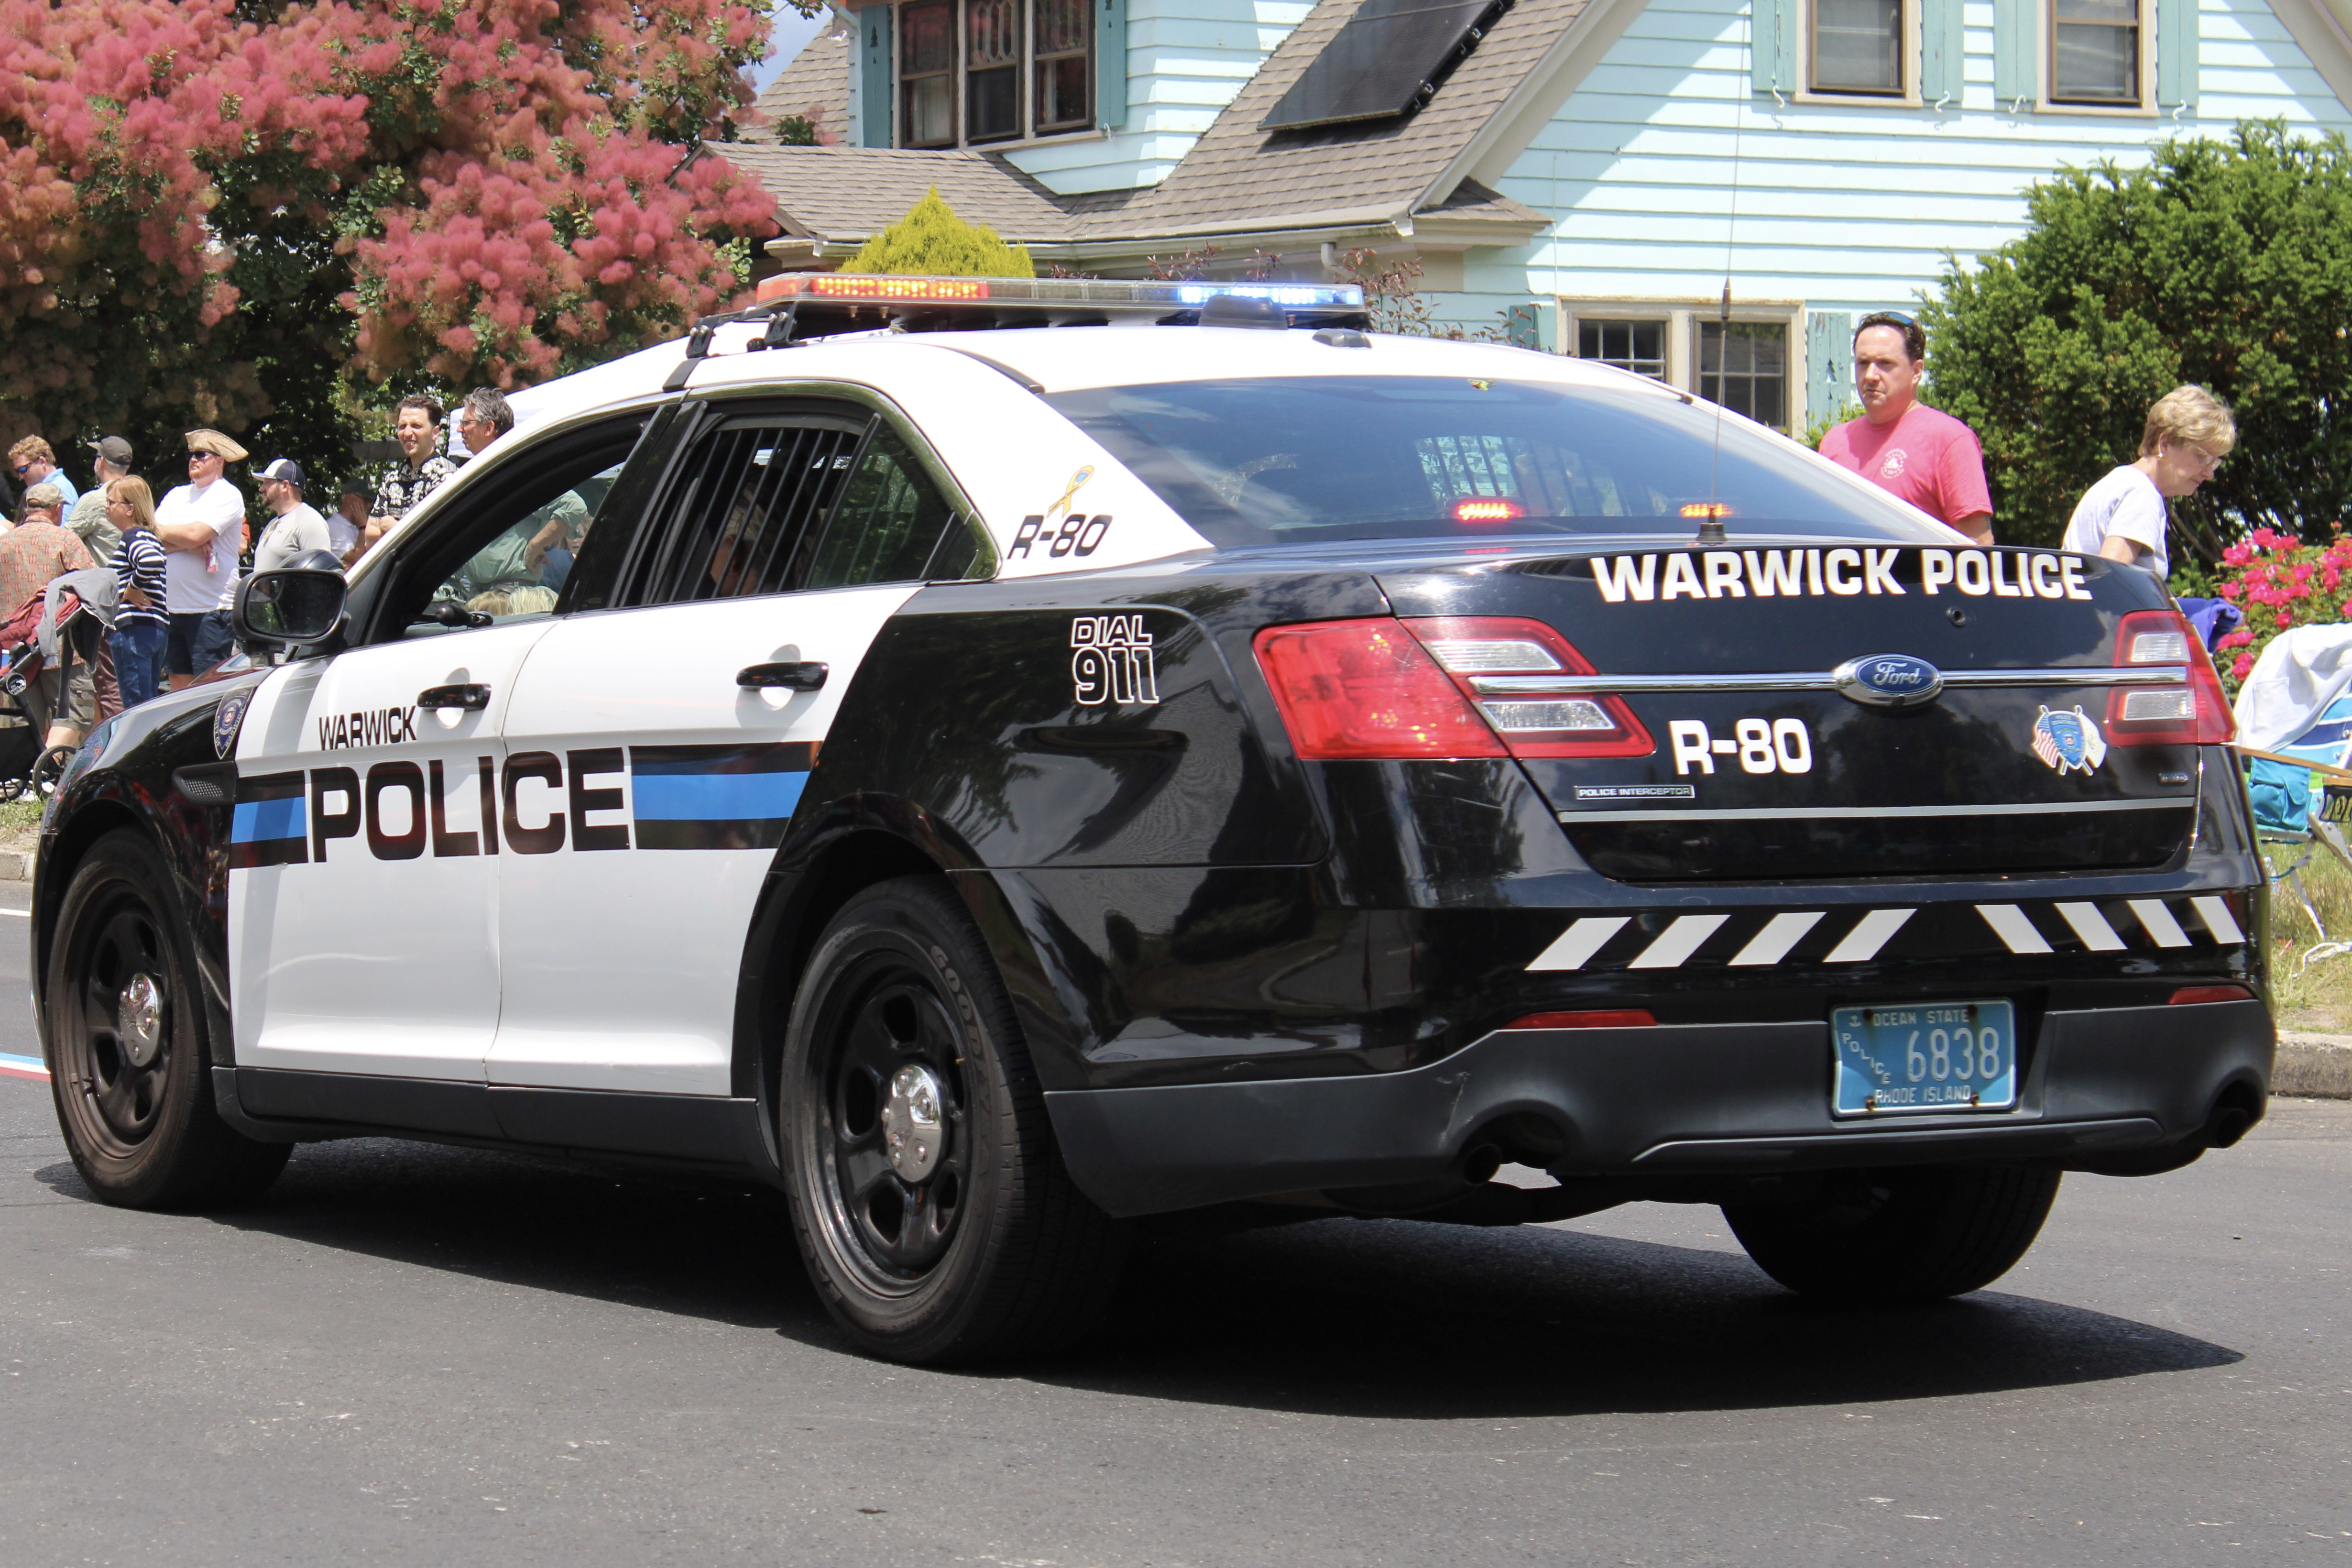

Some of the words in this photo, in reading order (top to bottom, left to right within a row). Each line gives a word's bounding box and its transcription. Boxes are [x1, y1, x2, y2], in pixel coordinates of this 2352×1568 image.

[1006, 514, 1113, 559] R-80
[1590, 548, 1907, 603] WARWICK
[1921, 549, 2093, 601] POLICE
[1070, 614, 1153, 647] DIAL
[1072, 646, 1160, 705] 911
[1874, 662, 1922, 686] Ford
[318, 705, 418, 751] WARWICK
[1669, 718, 1813, 776] R-80
[310, 746, 630, 864] POLICE
[1579, 788, 1617, 797] POLICE
[1619, 787, 1691, 796] INTERCEPTOR
[1873, 1011, 1916, 1027] OCEAN
[1926, 1010, 1970, 1024] STATE
[1841, 1032, 1892, 1085] POLICE
[1906, 1027, 2000, 1083] 6838
[1874, 1087, 1917, 1104] RHODE
[1923, 1085, 1971, 1102] ISLAND
